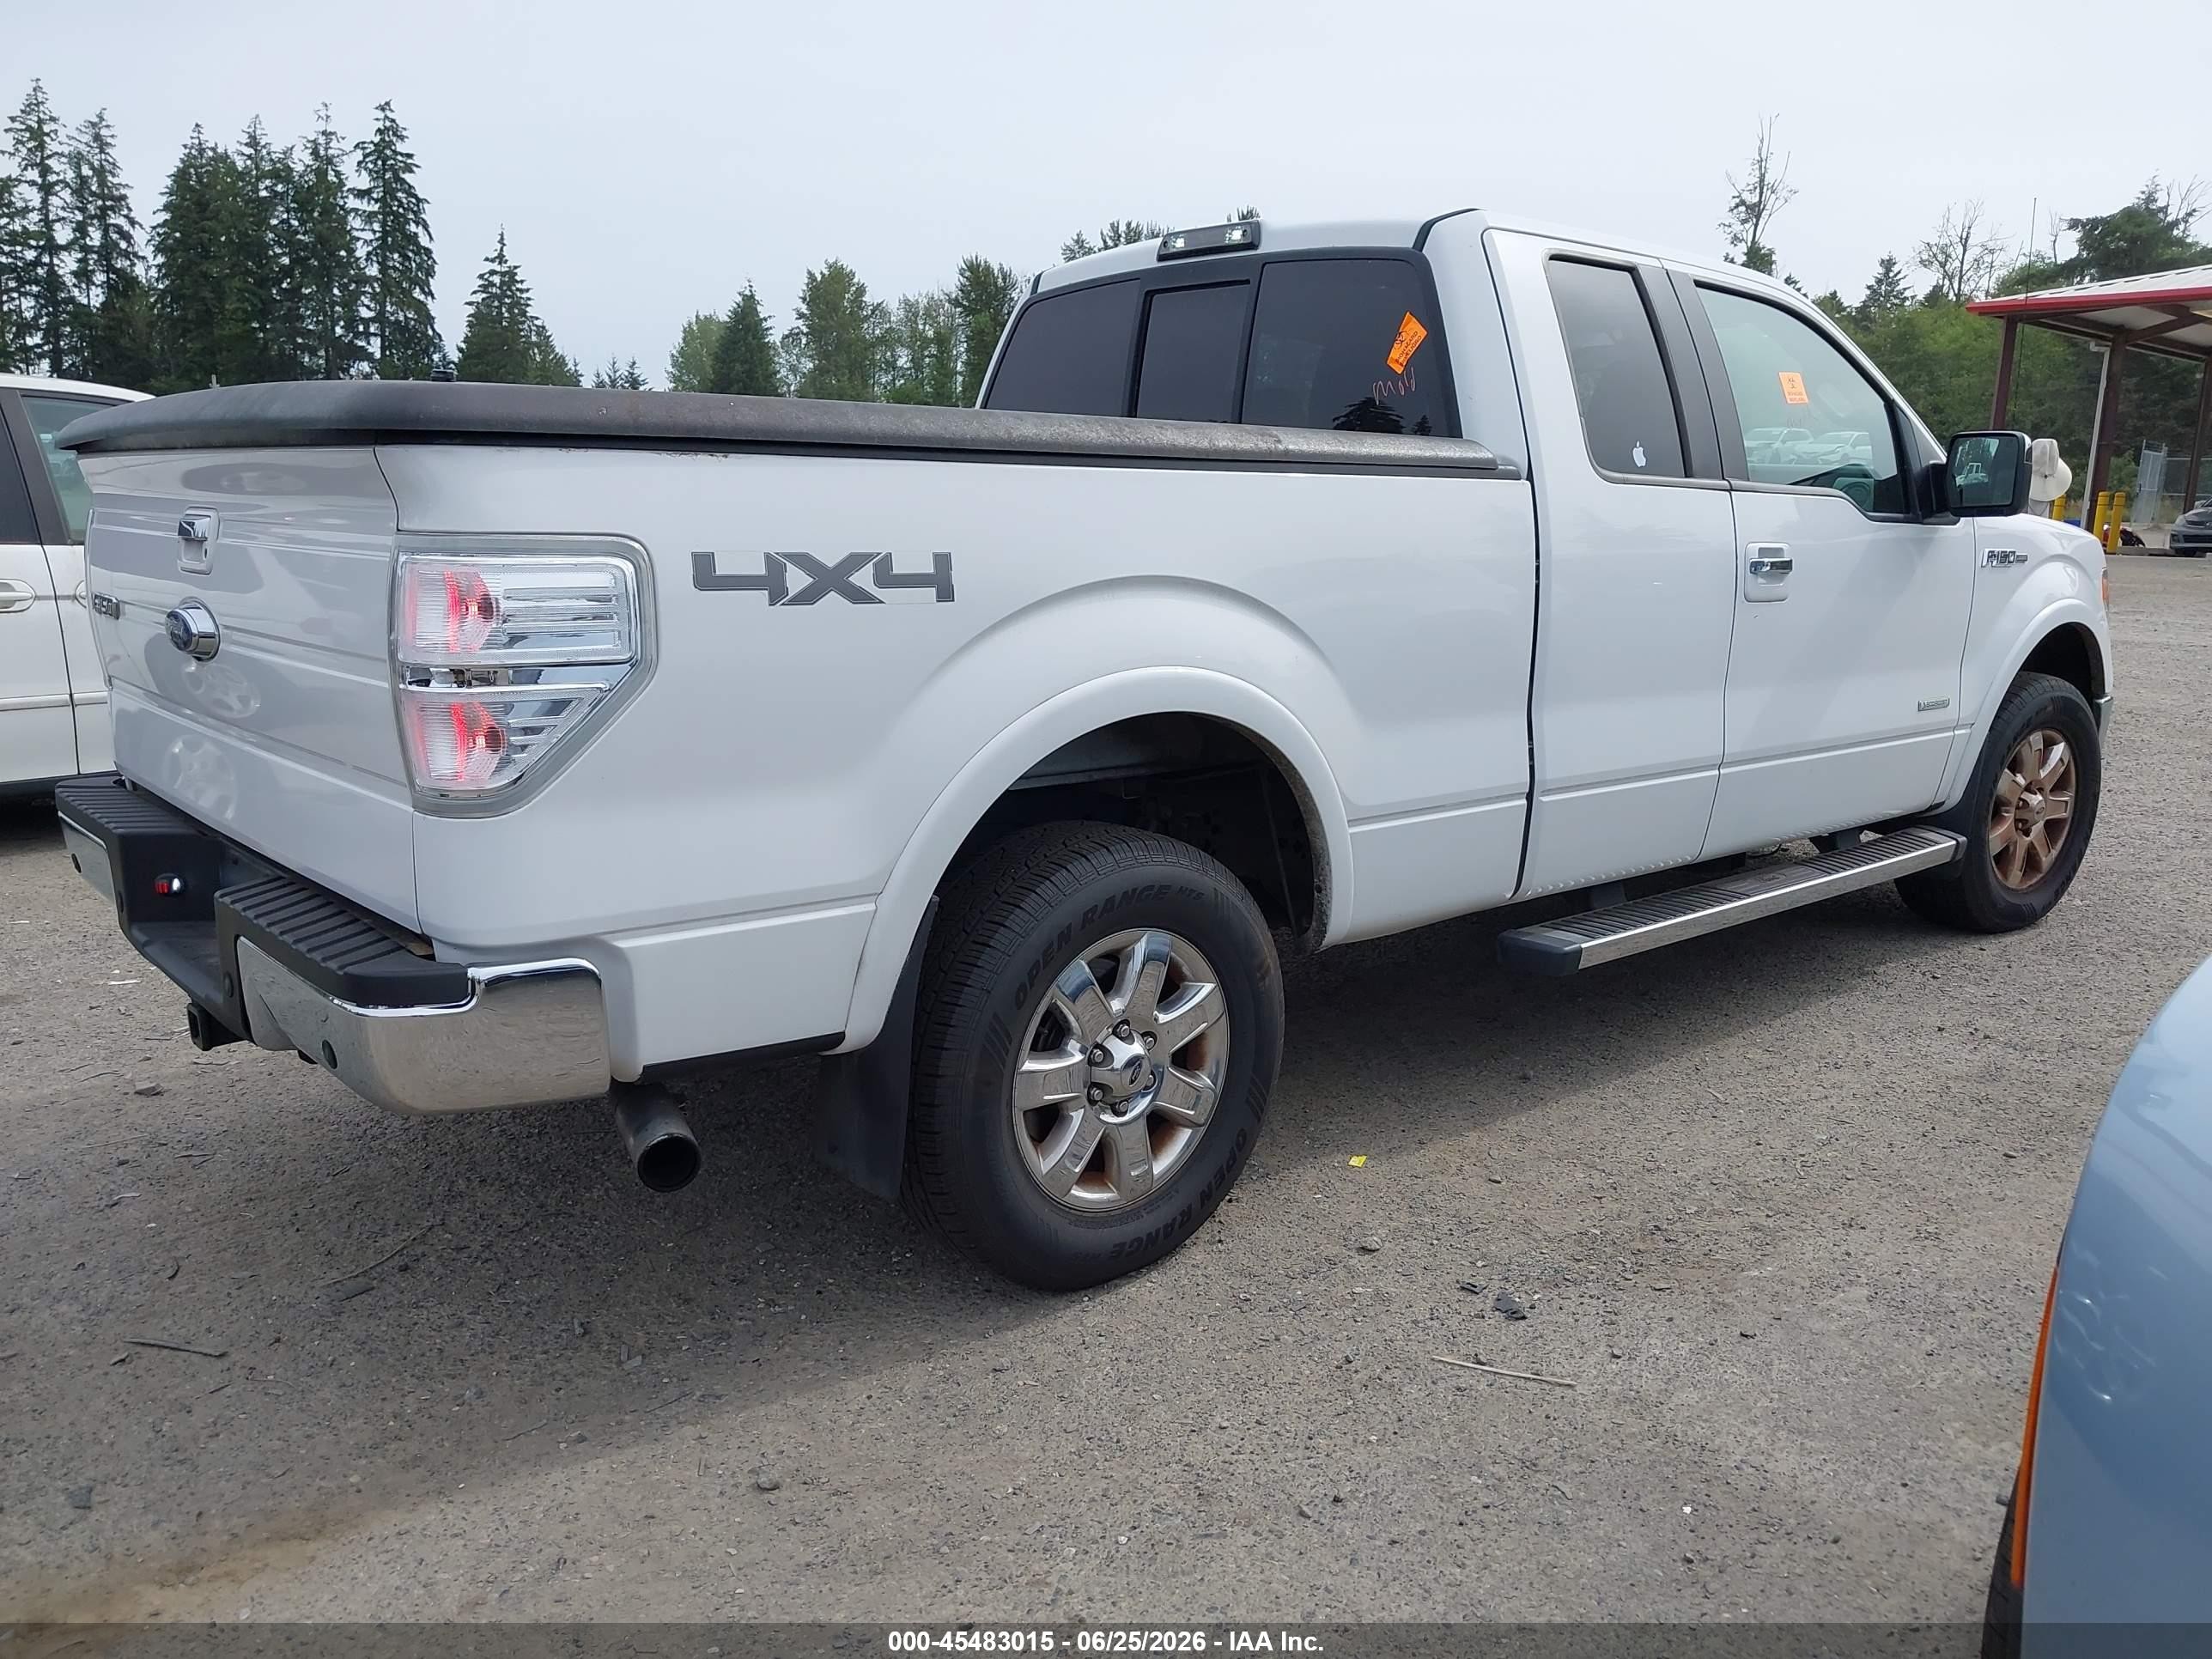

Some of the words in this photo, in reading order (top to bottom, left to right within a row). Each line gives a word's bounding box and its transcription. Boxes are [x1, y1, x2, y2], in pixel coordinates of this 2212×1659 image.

[1395, 331, 1419, 364] BIOHAZARD
[1015, 921, 1073, 1011] OPEN
[1079, 884, 1172, 931] RANGE
[1106, 1202, 1193, 1260] RANGE
